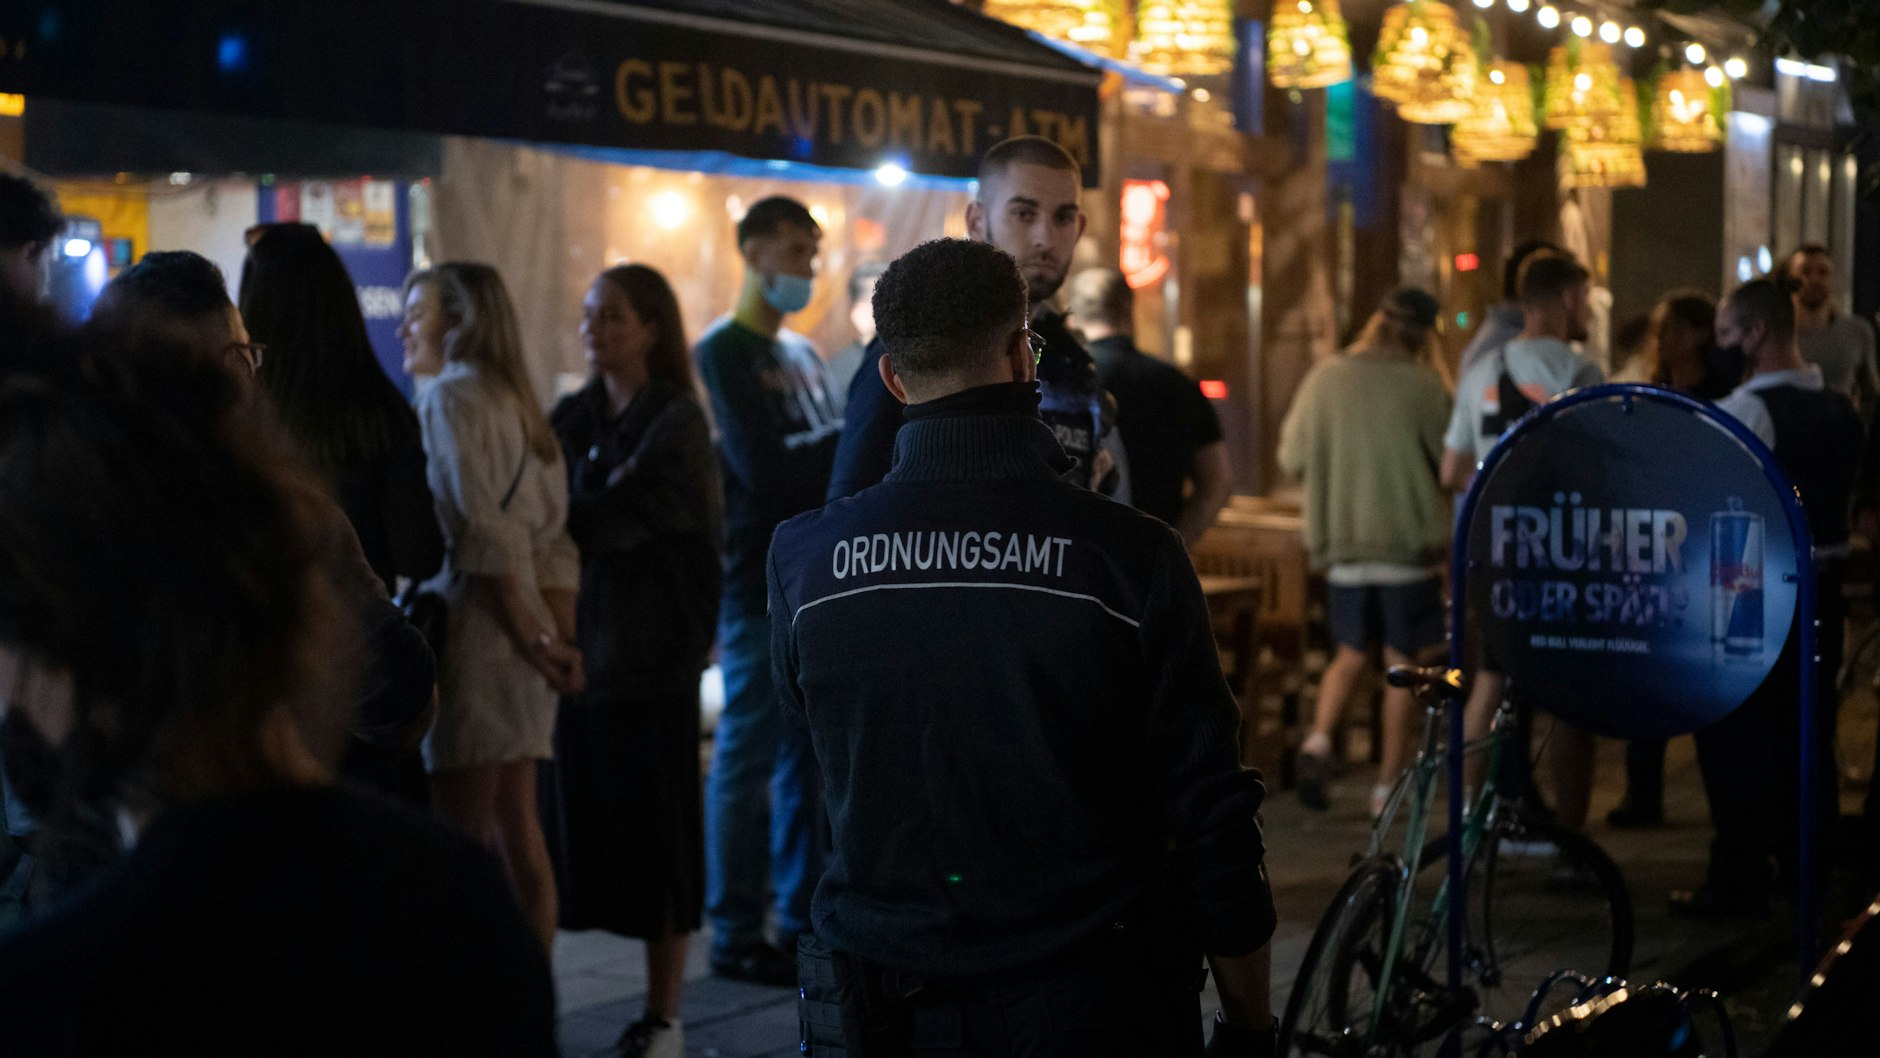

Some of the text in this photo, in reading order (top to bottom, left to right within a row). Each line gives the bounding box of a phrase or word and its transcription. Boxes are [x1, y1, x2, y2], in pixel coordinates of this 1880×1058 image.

[614, 57, 983, 157] GELDAUTOMAT
[832, 530, 1073, 580] ORDNUNGSAMT
[1490, 489, 1688, 574] FRÜHER
[1491, 577, 1577, 623] ODER
